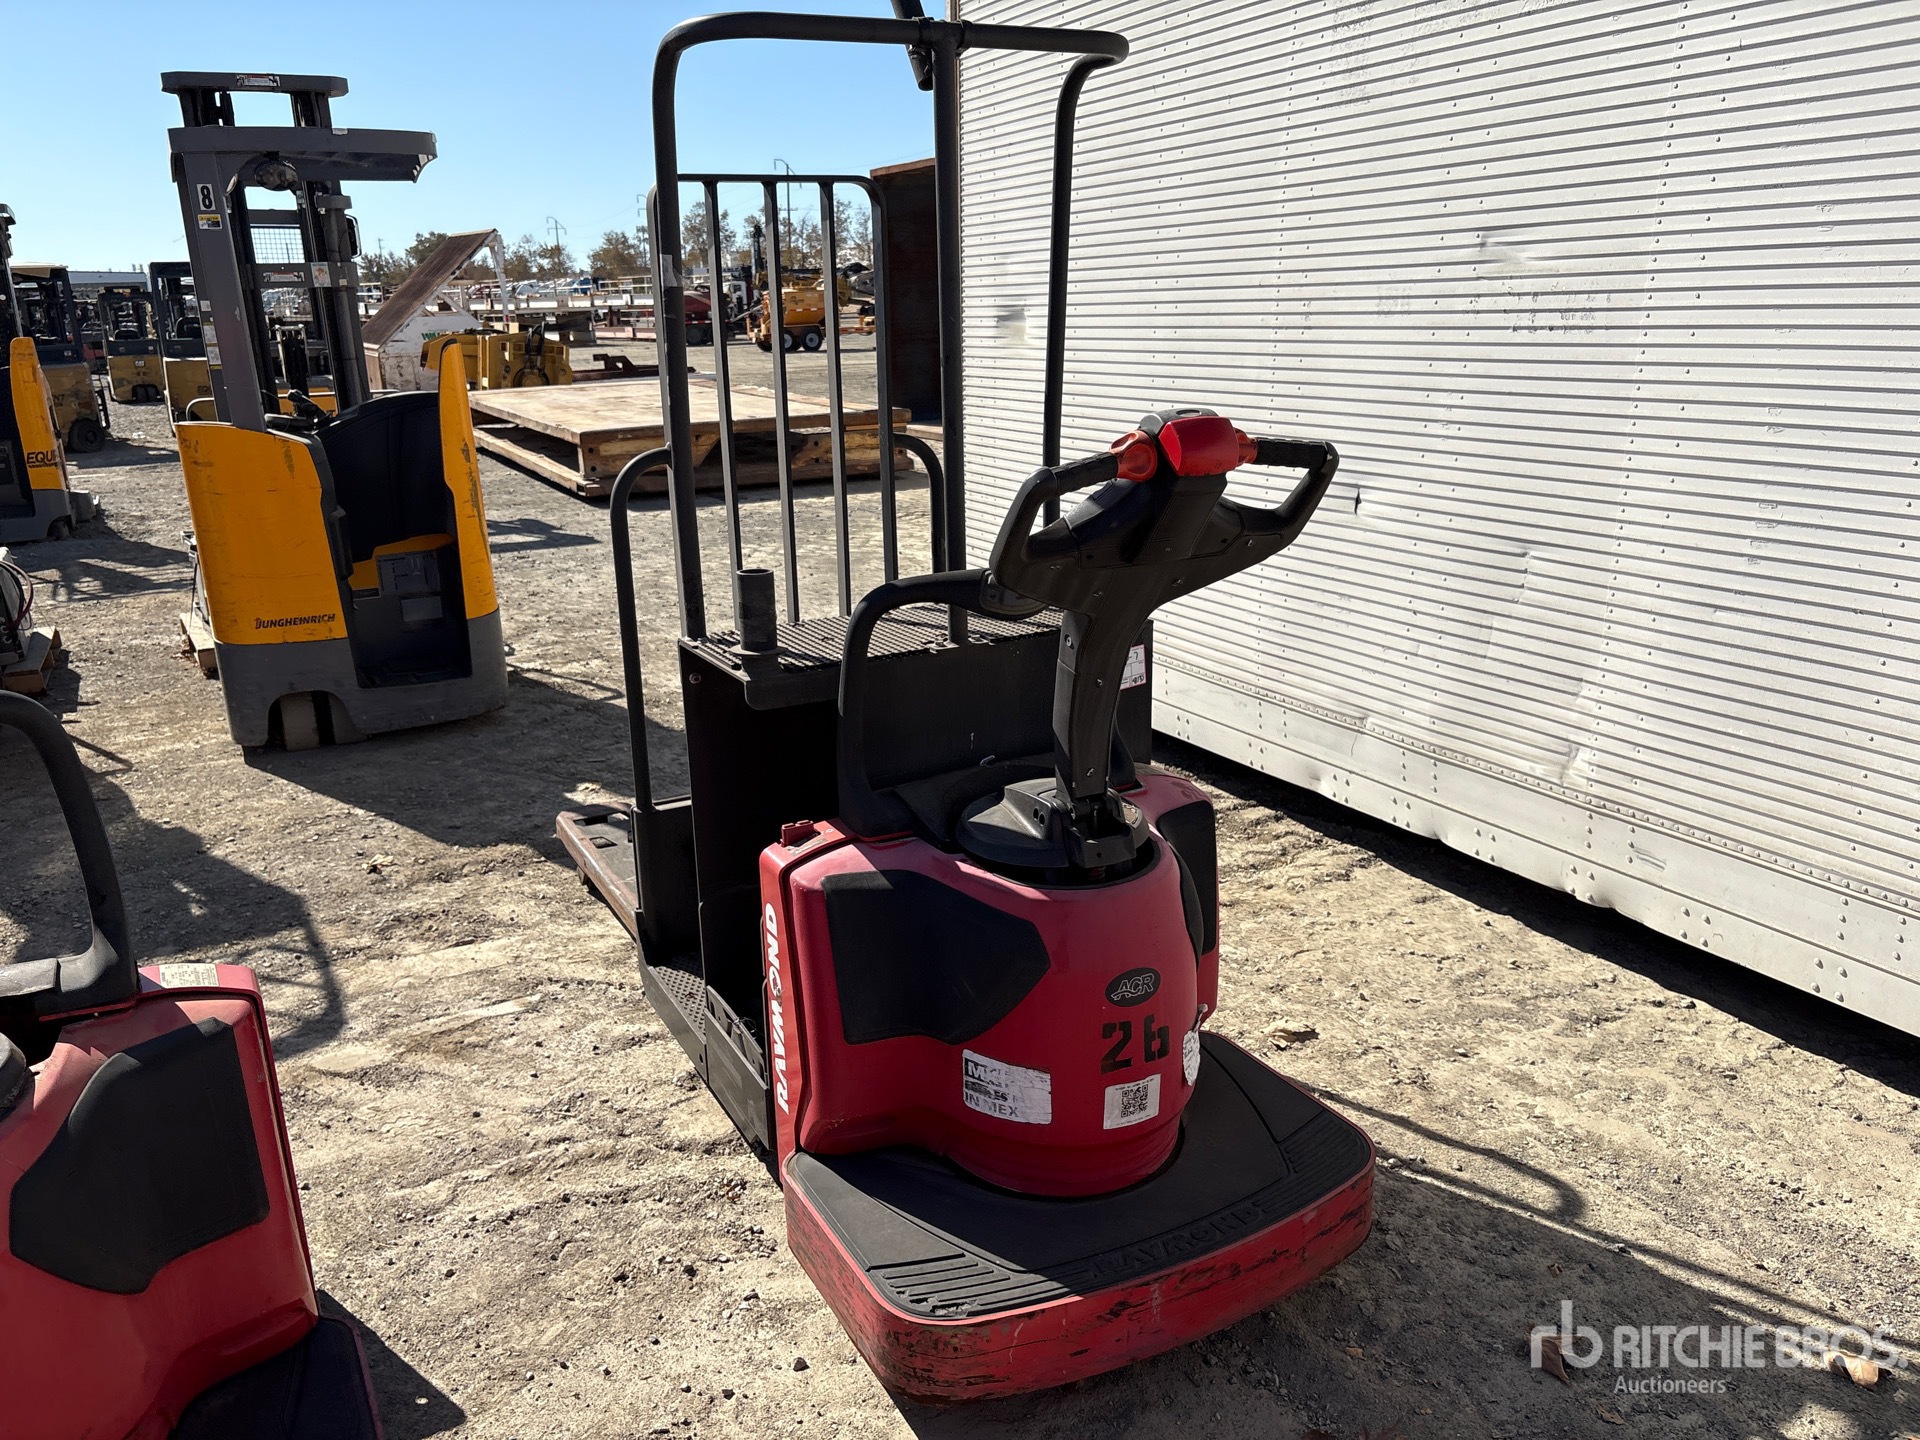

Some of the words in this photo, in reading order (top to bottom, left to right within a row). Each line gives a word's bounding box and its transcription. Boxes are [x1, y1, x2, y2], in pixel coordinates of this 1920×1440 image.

[200, 185, 213, 209] 8
[255, 613, 336, 629] JUNGHEINRICH
[1110, 972, 1155, 1001] ACR
[765, 902, 790, 1115] RAYMOND
[1101, 1014, 1170, 1074] 26
